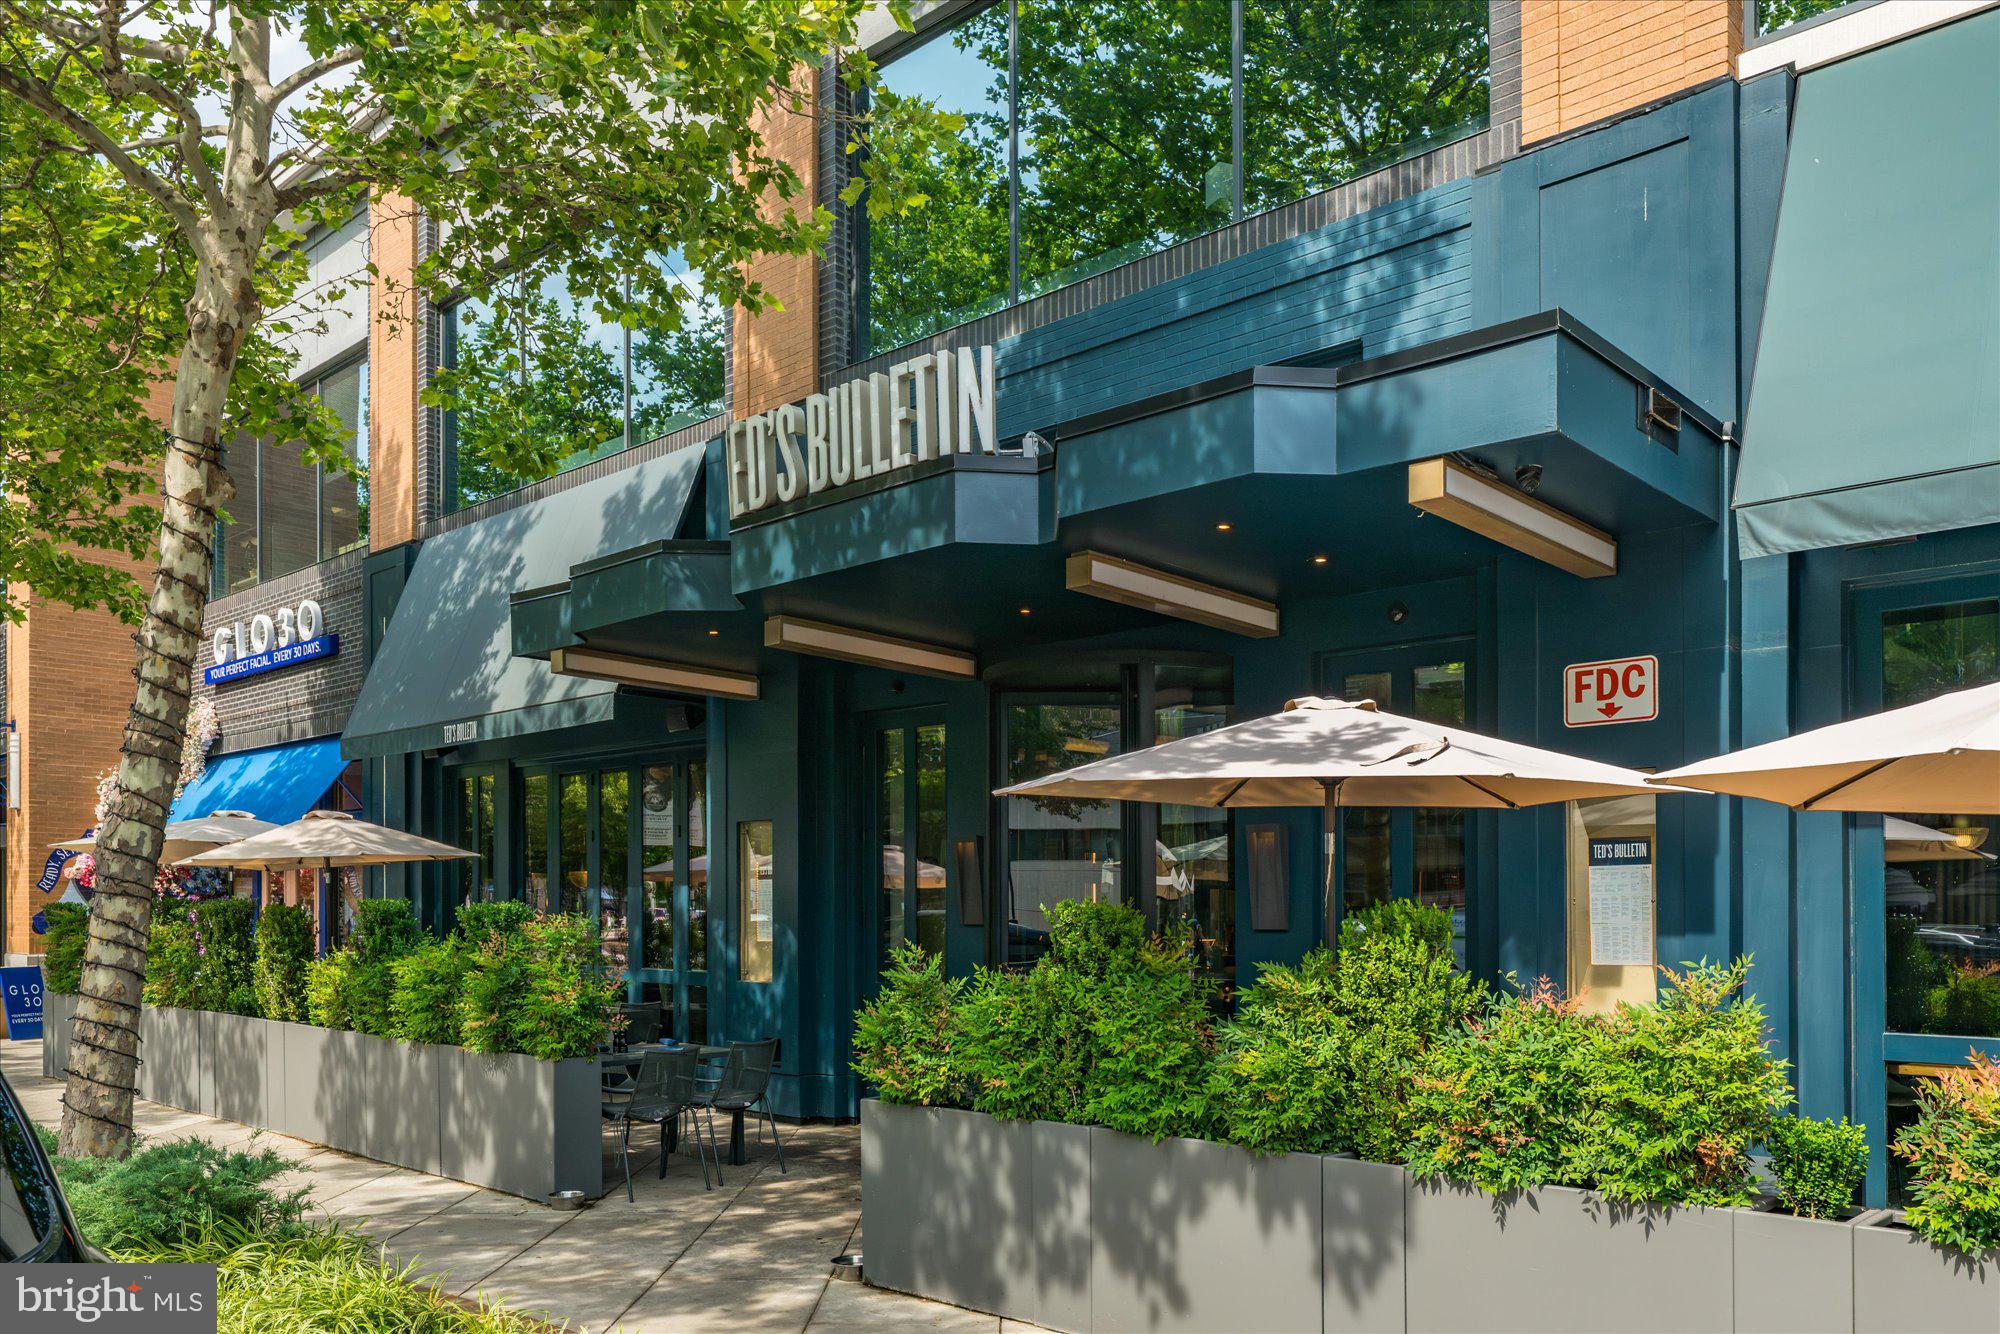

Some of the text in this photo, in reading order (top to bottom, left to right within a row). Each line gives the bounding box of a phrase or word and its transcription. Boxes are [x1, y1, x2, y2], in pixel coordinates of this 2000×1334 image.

[726, 344, 996, 520] ED'S BULLETIN
[210, 641, 321, 679] YOUR PERFECT FACIAL. EVERY 30 DAYS.
[1574, 664, 1645, 703] FDC
[443, 720, 477, 744] TED'S BULLETIN
[1593, 842, 1647, 859] TED'S BULLETIN
[9, 984, 40, 996] GLO
[24, 996, 42, 1007] 30
